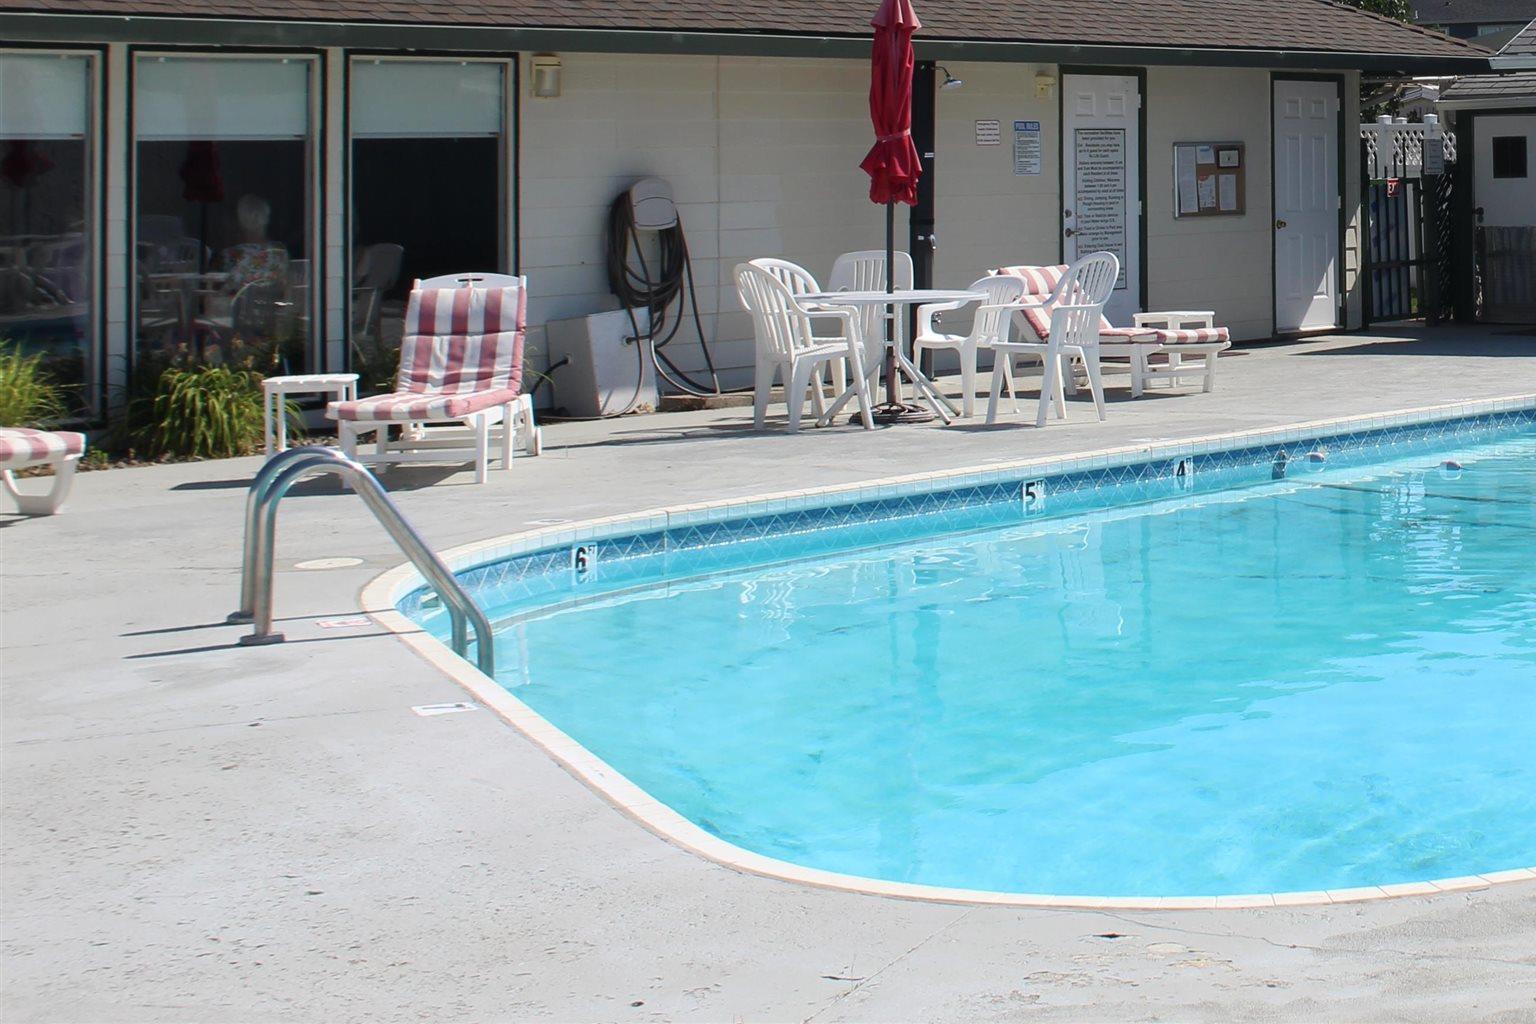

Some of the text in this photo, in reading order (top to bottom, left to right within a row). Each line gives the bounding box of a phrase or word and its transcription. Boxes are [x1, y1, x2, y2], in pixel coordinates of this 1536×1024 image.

[1177, 460, 1185, 476] 4
[1026, 482, 1036, 504] 5
[576, 547, 587, 573] 6
